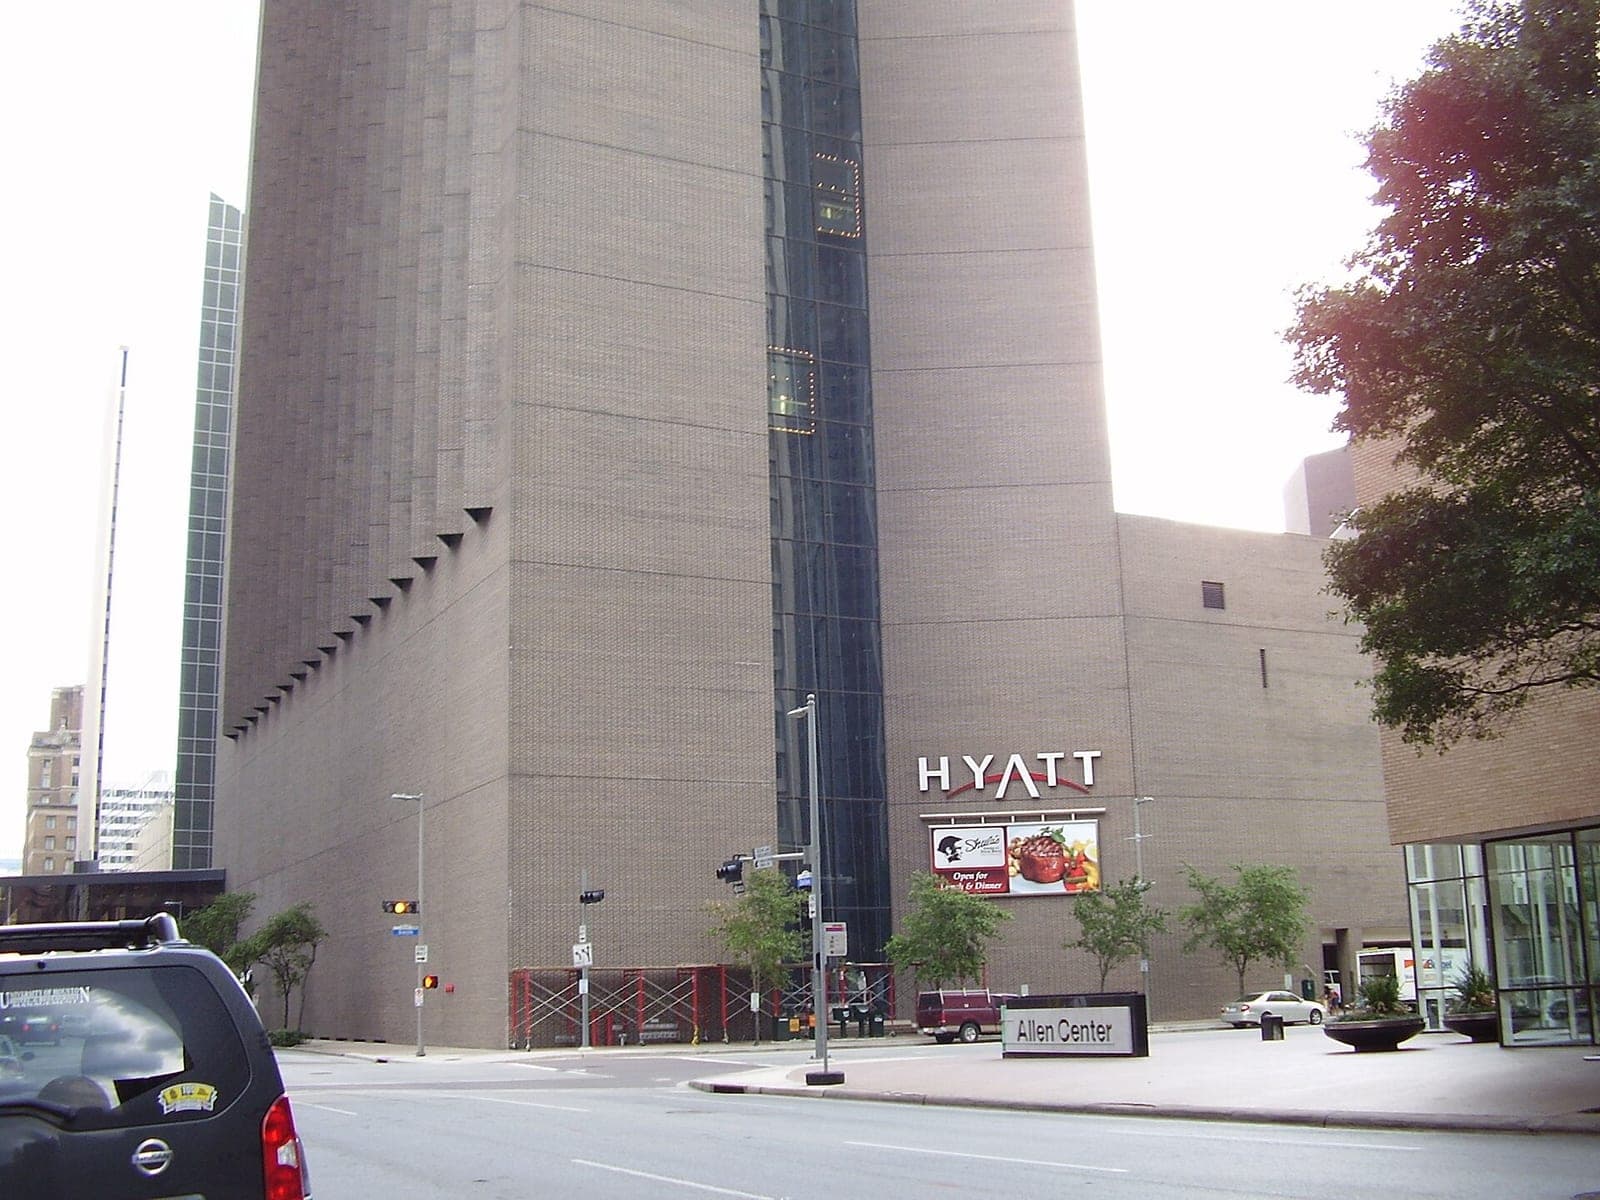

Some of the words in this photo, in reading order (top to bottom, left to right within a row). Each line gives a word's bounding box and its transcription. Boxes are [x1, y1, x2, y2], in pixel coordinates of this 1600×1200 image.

[918, 750, 1102, 799] HYATT
[953, 871, 975, 882] Open
[975, 871, 988, 882] for
[965, 882, 974, 890] &
[975, 882, 1003, 890] Dinner
[1017, 1019, 1054, 1042] Allen
[1058, 1019, 1112, 1042] Center
